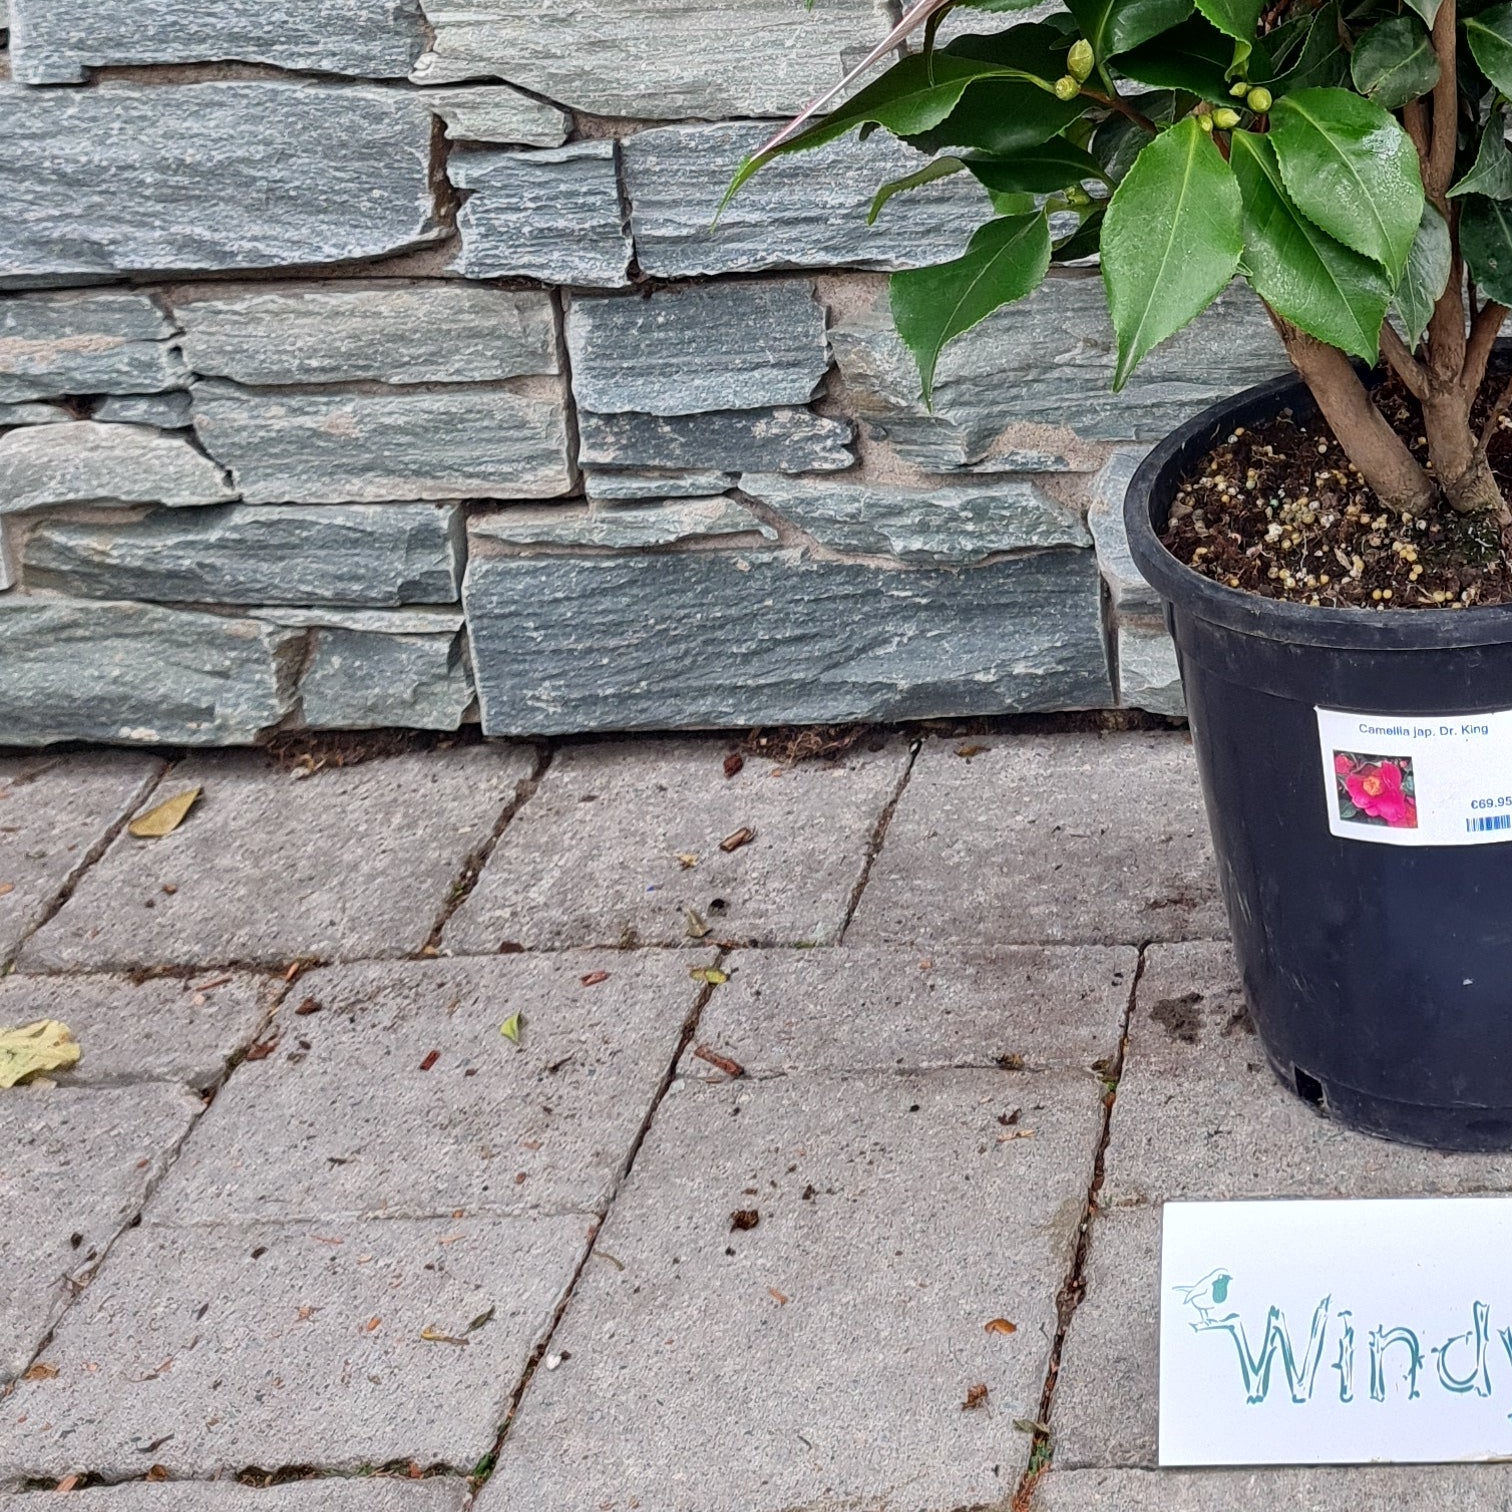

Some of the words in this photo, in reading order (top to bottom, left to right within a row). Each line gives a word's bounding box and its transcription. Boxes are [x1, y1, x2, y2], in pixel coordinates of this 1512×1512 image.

[1358, 723, 1410, 737] Camellia
[1412, 726, 1436, 739] jap.
[1439, 726, 1458, 736] Dr.
[1461, 724, 1489, 736] King
[1471, 796, 1512, 809] €69.95
